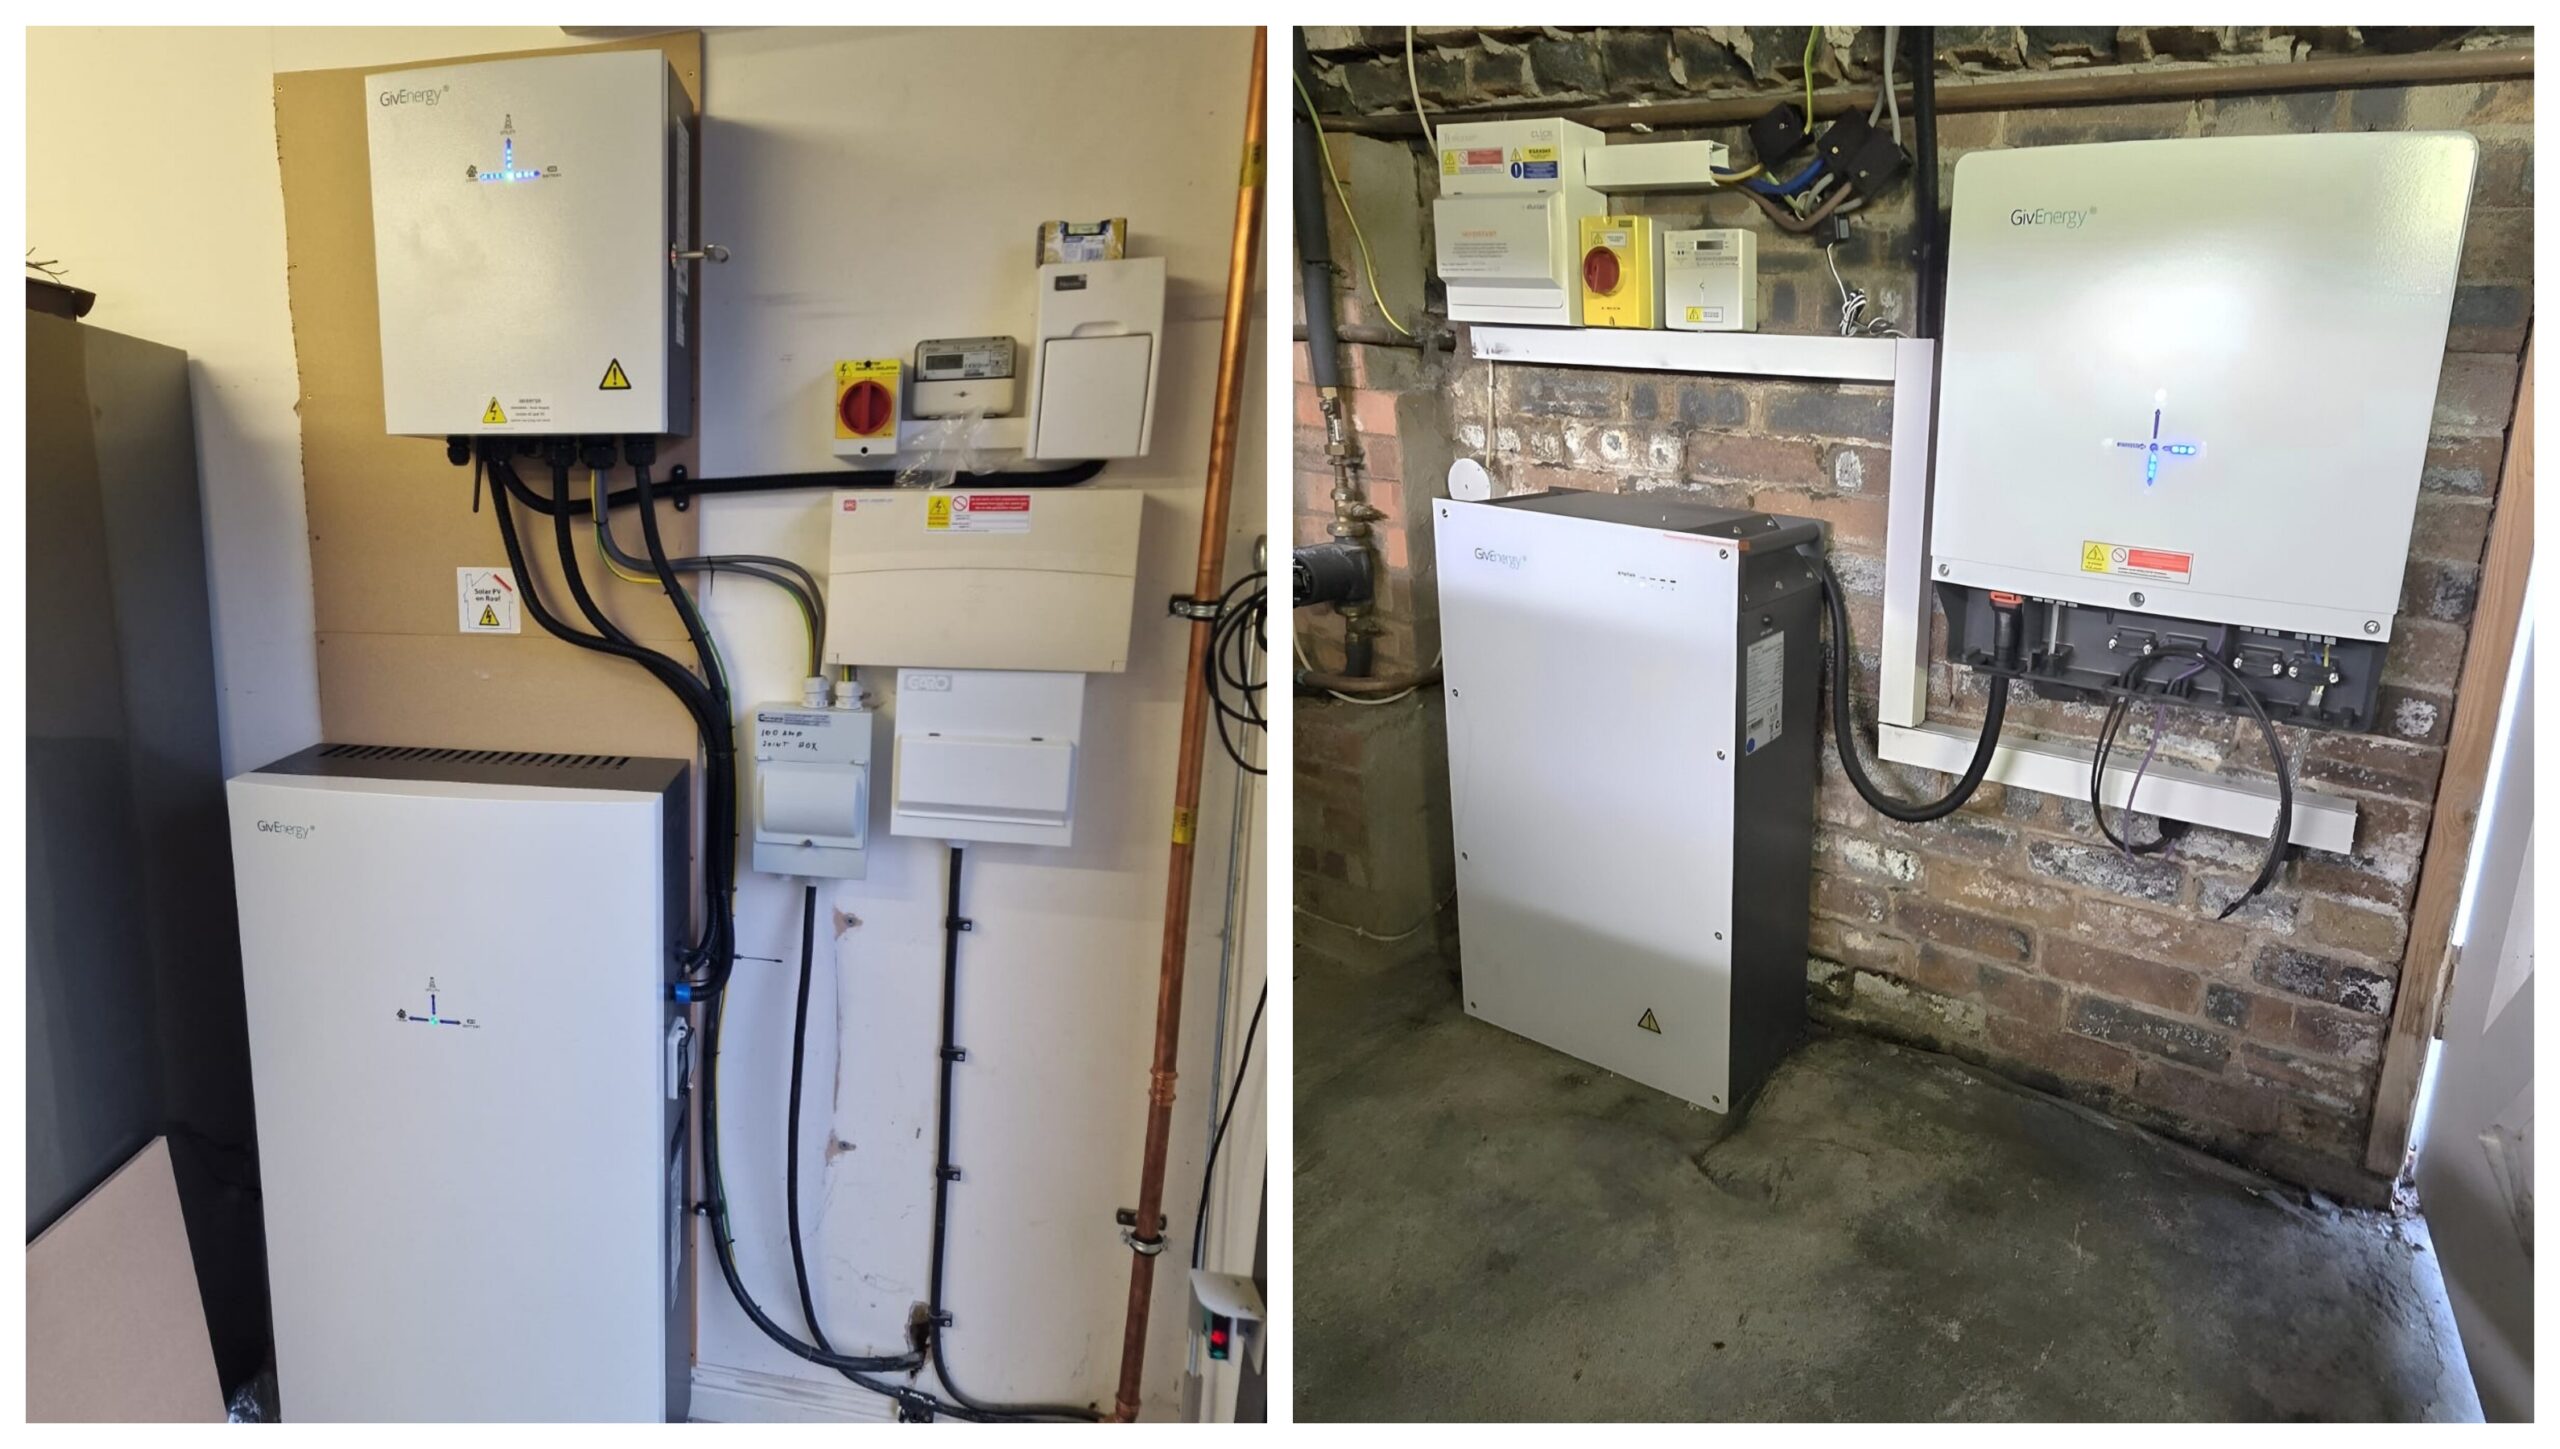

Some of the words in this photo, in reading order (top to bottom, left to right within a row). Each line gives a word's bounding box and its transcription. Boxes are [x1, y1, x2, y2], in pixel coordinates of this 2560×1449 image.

[380, 89, 442, 106] GivEnergy
[2011, 208, 2088, 229] GivEnergy
[1474, 547, 1520, 570] GivEnergy
[907, 675, 950, 690] GARO
[257, 820, 309, 840] GivEnergy
